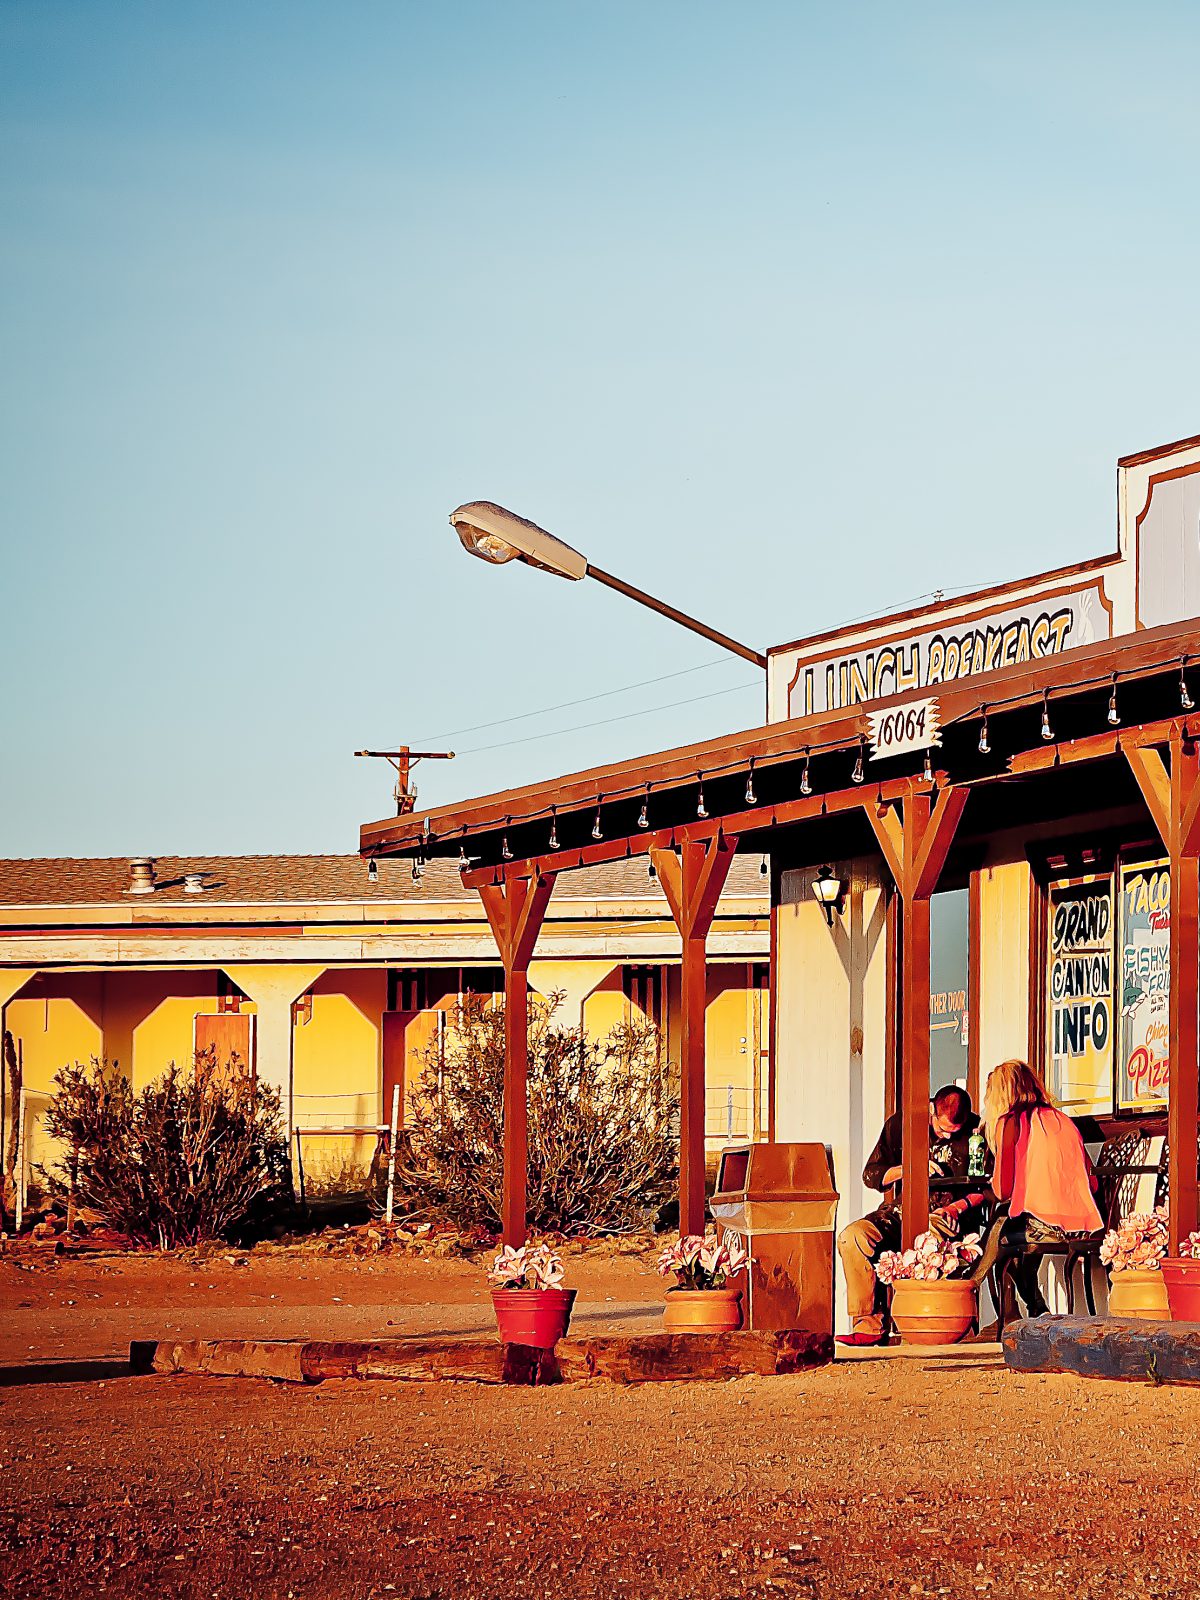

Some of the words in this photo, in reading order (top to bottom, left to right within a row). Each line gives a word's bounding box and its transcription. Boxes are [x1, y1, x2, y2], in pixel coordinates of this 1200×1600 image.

[805, 642, 920, 715] LUNCH
[877, 706, 928, 748] 16064
[1053, 895, 1110, 952] GRAND
[930, 992, 947, 1015] THER
[1051, 953, 1110, 1002] CANYON
[1054, 1001, 1109, 1058] INFO
[1127, 1046, 1170, 1098] Pizz
